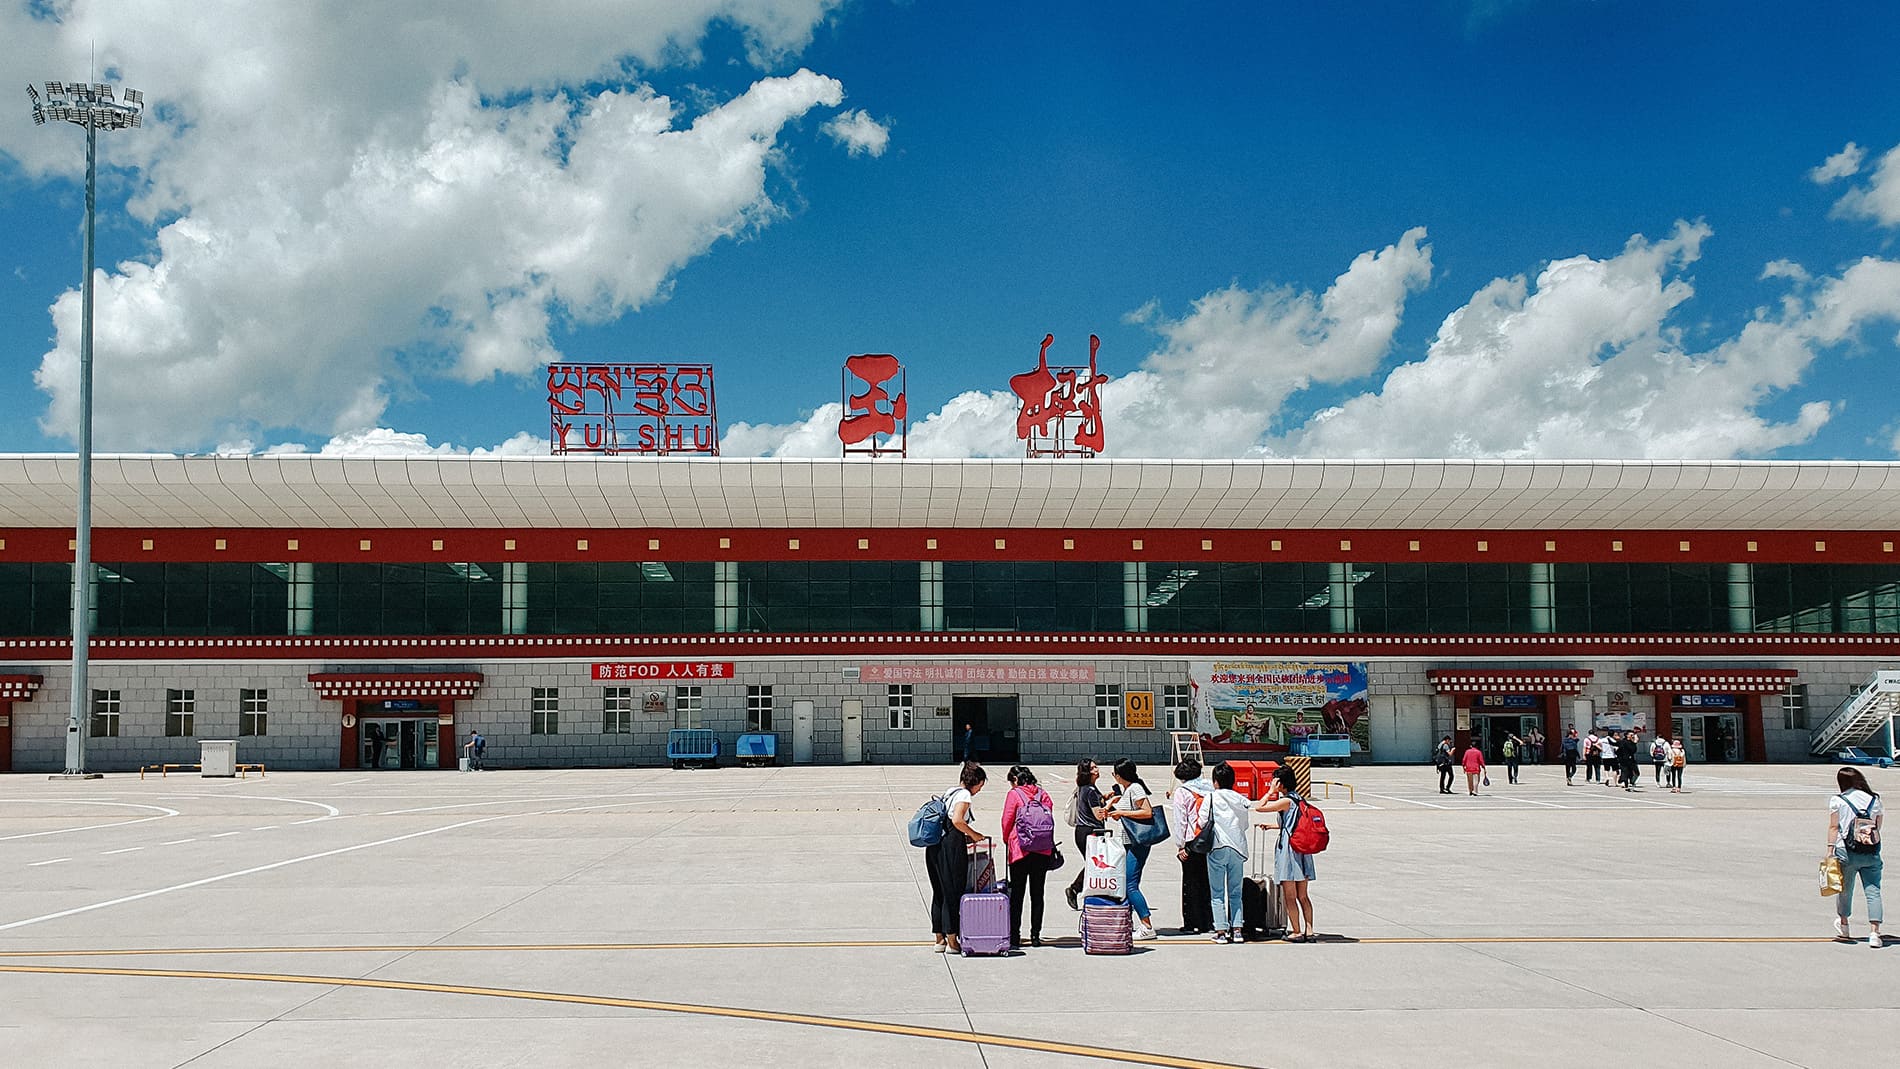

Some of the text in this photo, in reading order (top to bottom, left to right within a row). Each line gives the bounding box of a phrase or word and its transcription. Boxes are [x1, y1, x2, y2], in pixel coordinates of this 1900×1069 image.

[553, 424, 711, 450] YU SHU
[599, 663, 724, 678] 防范FOD 人人有责
[883, 667, 923, 679] 爱国守法
[925, 667, 964, 679] 明礼诚信
[966, 667, 1005, 679] 团结友善
[1008, 668, 1047, 680] 勤俭自强
[1049, 668, 1089, 680] 敬业奉献
[1130, 695, 1149, 711] 01
[1089, 877, 1118, 890] UUS
